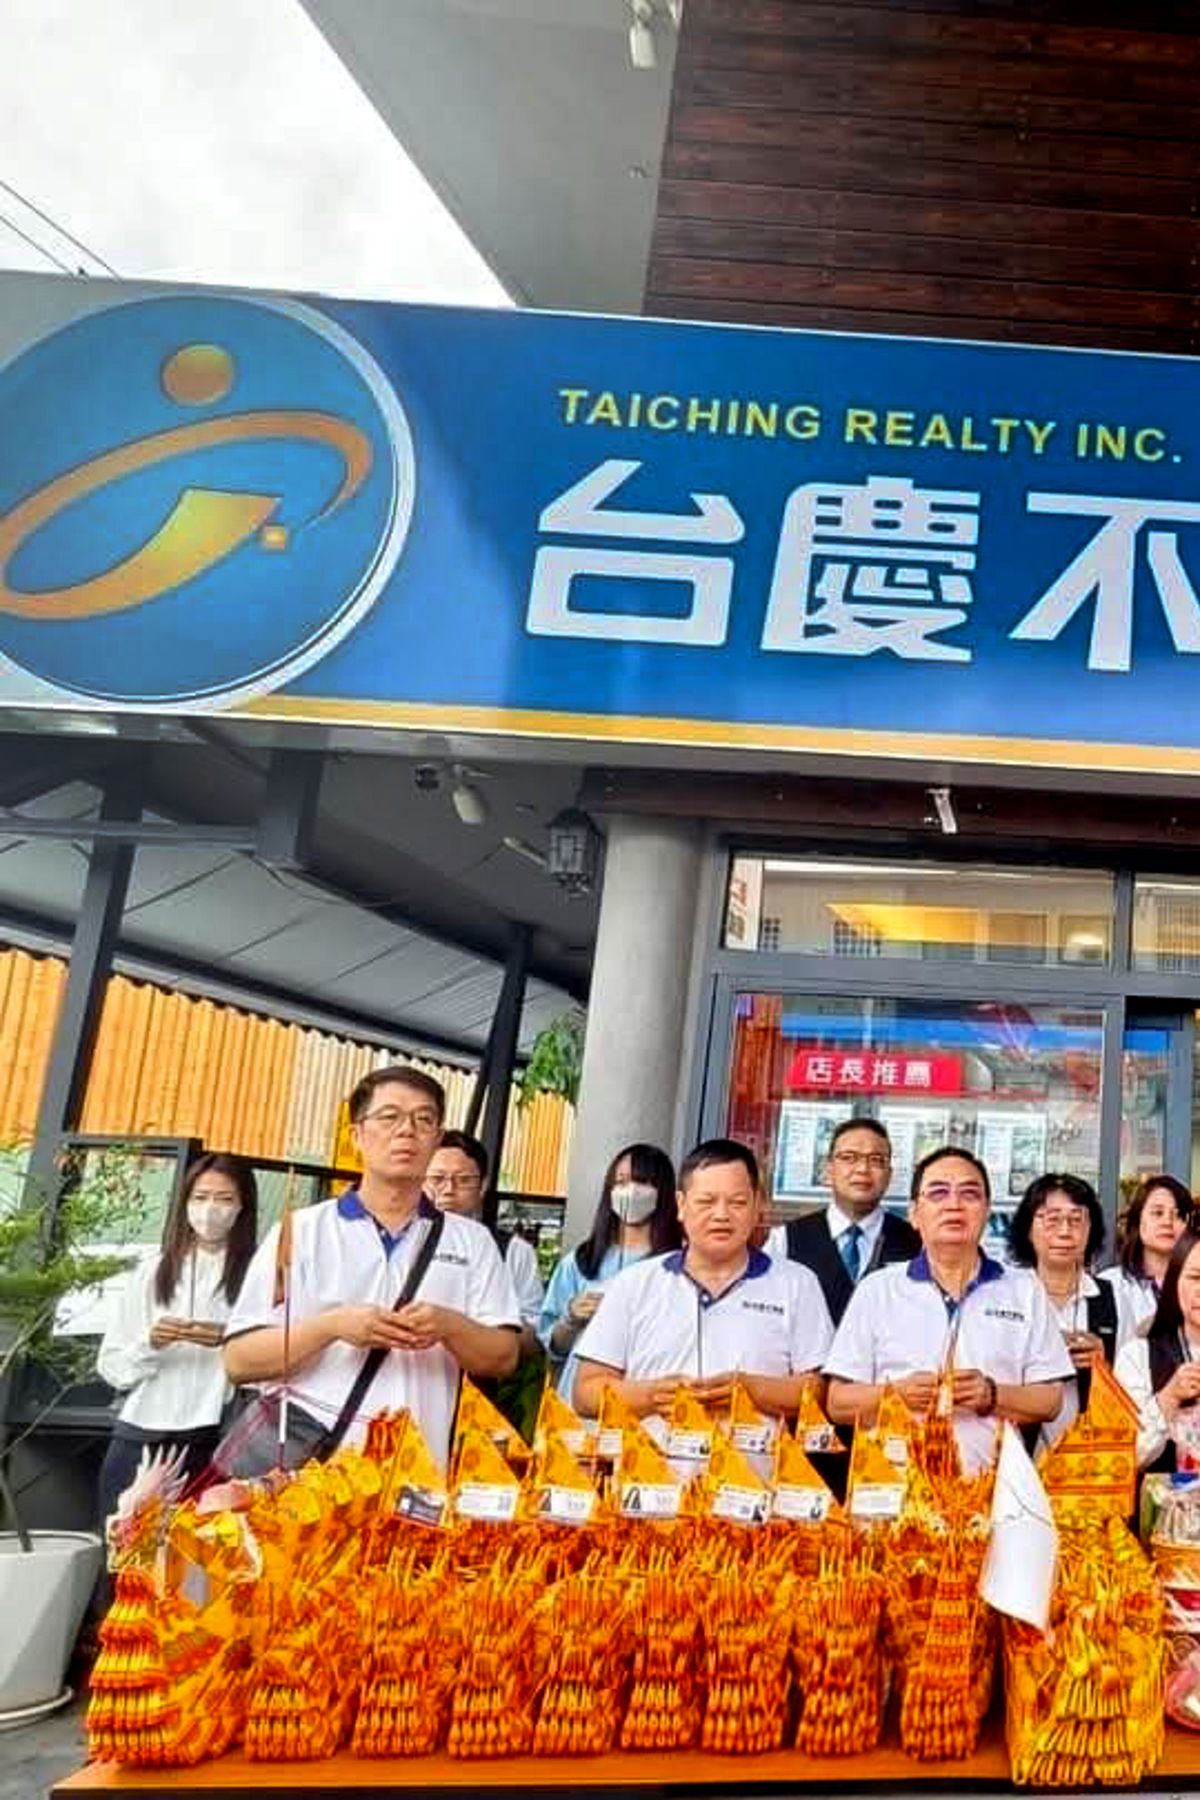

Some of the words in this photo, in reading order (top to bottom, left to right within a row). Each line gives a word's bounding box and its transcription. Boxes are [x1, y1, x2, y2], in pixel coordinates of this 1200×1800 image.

[559, 389, 822, 440] TAICHING
[845, 408, 1057, 455] REALTY
[1076, 423, 1184, 464] INC.
[805, 1056, 933, 1088] 店長推薦
